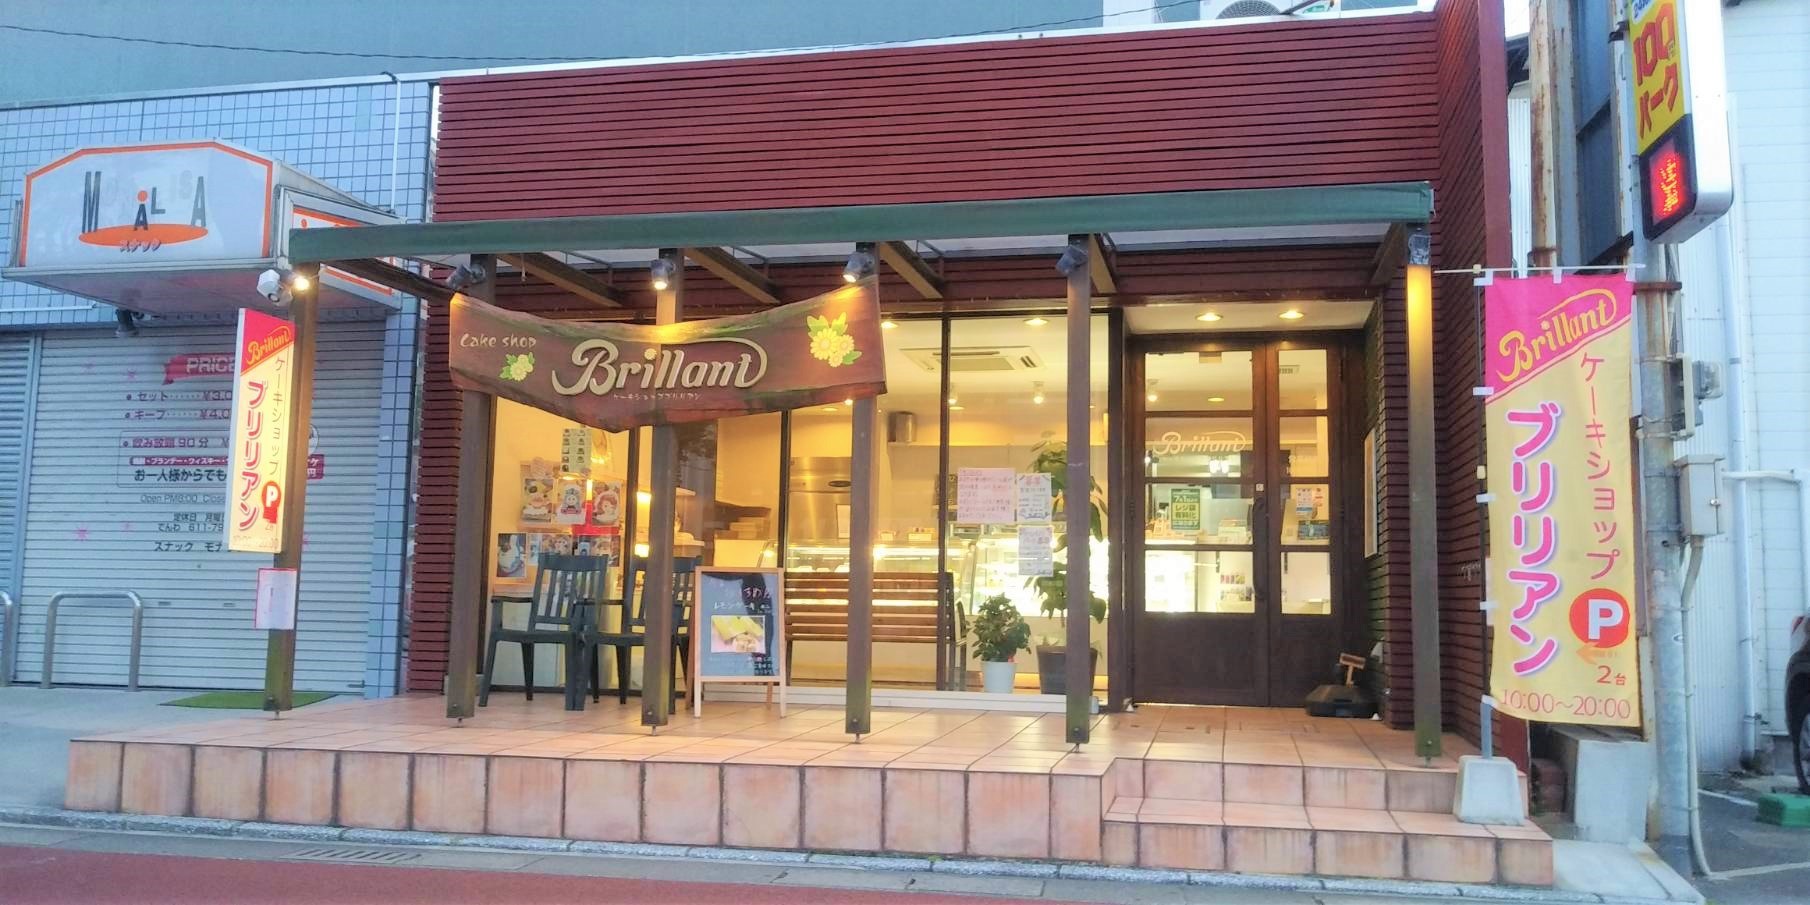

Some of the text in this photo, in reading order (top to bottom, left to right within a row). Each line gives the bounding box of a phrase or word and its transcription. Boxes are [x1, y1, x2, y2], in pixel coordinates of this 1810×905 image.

[119, 239, 161, 252] スナック
[245, 325, 292, 366] Brillant
[459, 333, 537, 351] Cake shop
[1496, 288, 1618, 382] Brillant
[552, 337, 769, 396] Brillant
[268, 356, 286, 475] ケーキショップ
[238, 380, 268, 531] ブリリアン
[1153, 430, 1247, 455] Brillant
[1580, 351, 1621, 580] ケーキショップ
[154, 541, 193, 553] スナック
[1507, 402, 1561, 675] ブリリアン
[1588, 598, 1623, 640] P
[1597, 665, 1627, 686] 2台
